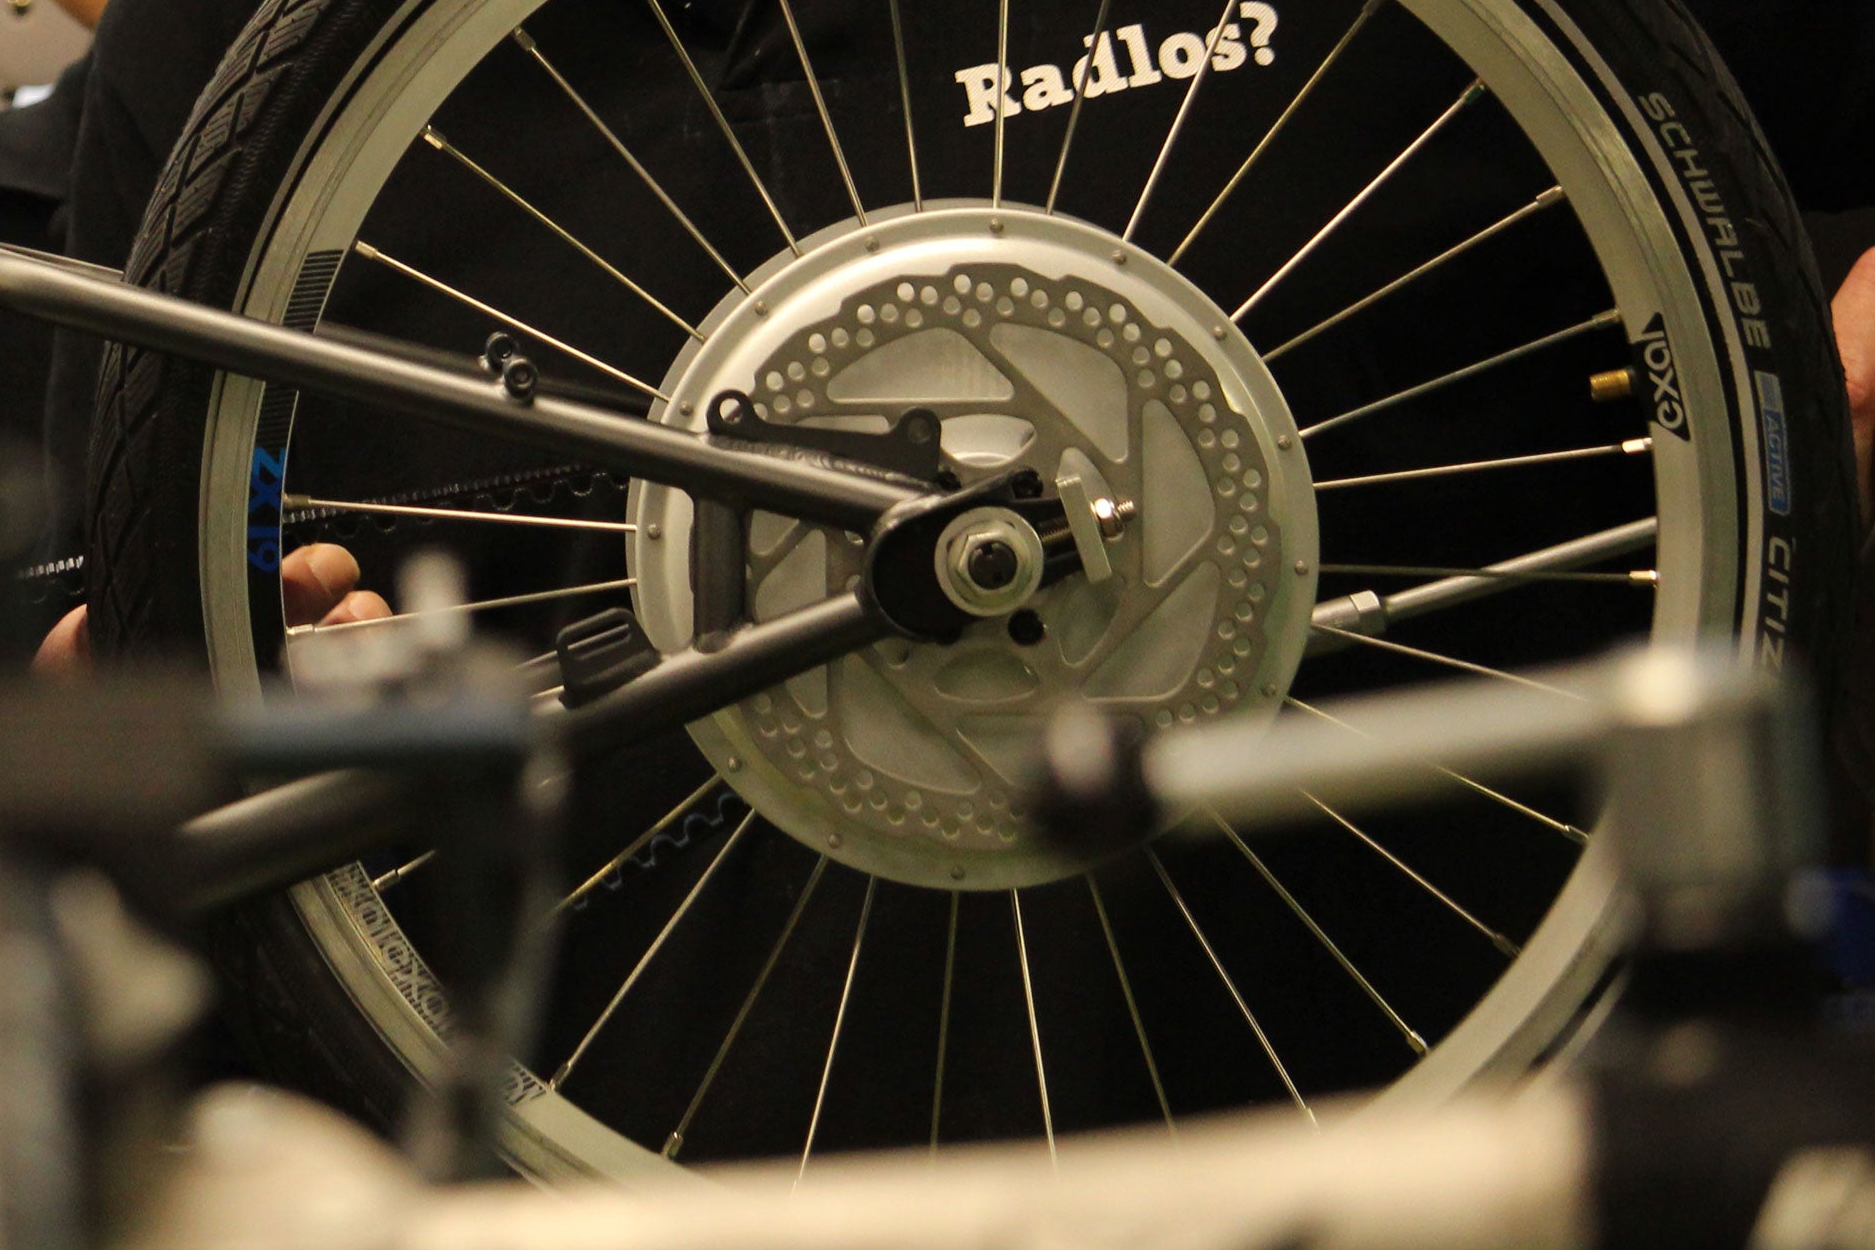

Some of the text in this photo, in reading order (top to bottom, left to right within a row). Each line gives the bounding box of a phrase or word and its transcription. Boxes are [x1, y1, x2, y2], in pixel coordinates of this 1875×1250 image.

[955, 0, 1279, 128] Radlos?
[1637, 91, 1773, 351] SCHWALBE
[1633, 329, 1685, 430] exal
[1763, 412, 1787, 502] ACTIVE
[1760, 535, 1791, 674] CITIZ
